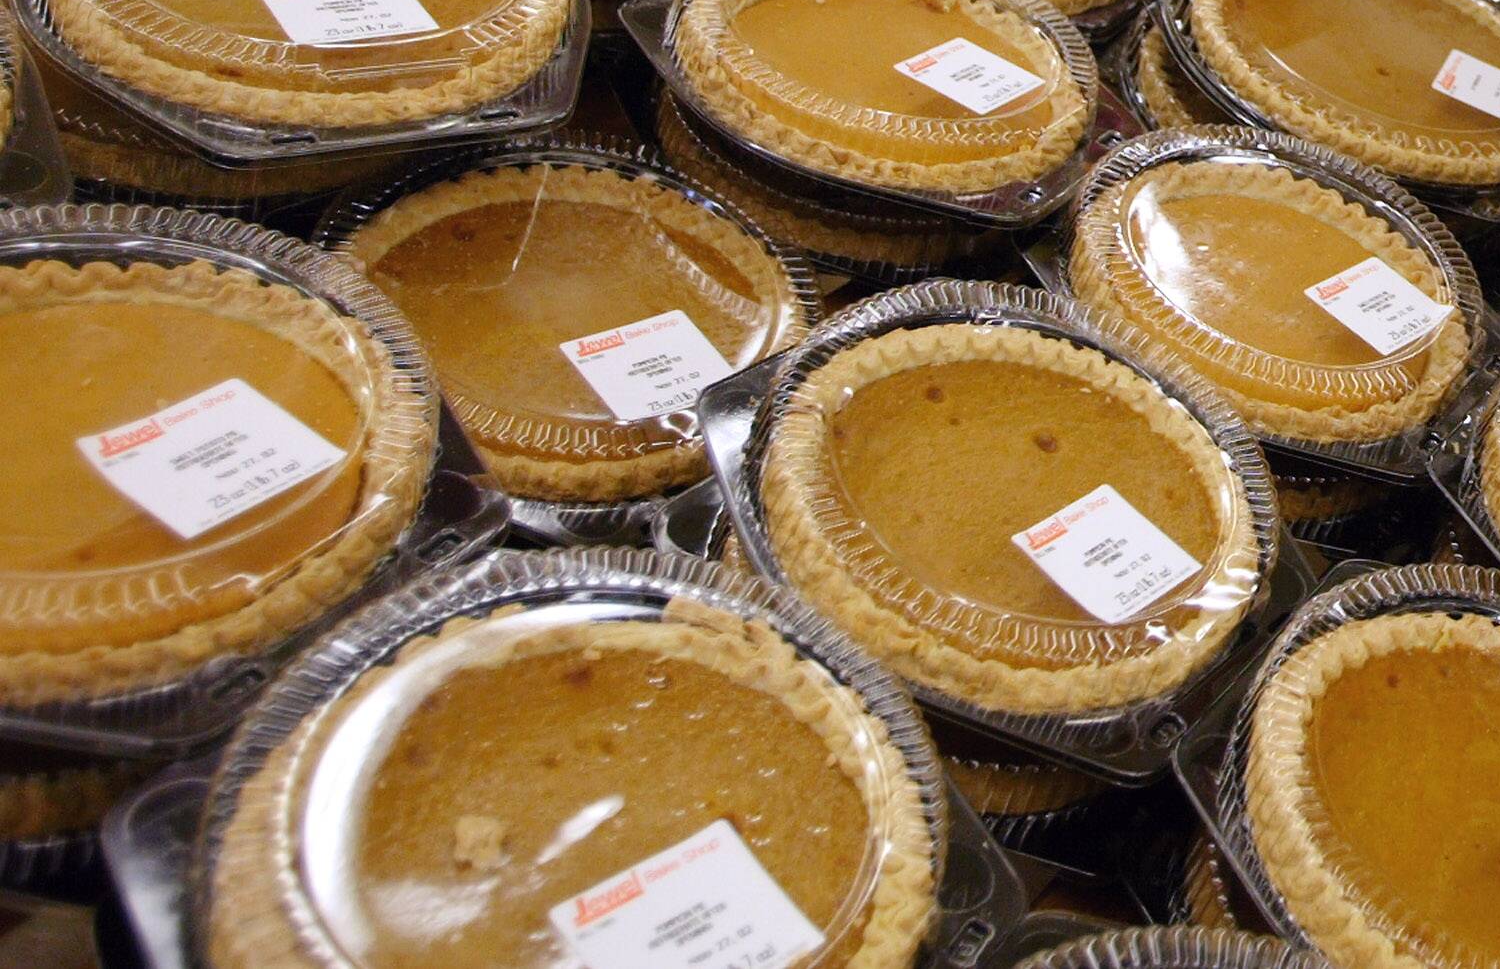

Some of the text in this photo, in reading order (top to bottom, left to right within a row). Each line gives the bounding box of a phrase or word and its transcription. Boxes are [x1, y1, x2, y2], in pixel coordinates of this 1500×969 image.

[577, 331, 625, 357] Jewel
[99, 417, 165, 458] Jewel
[1026, 517, 1068, 550] Jewel
[574, 872, 646, 928] Jewel
